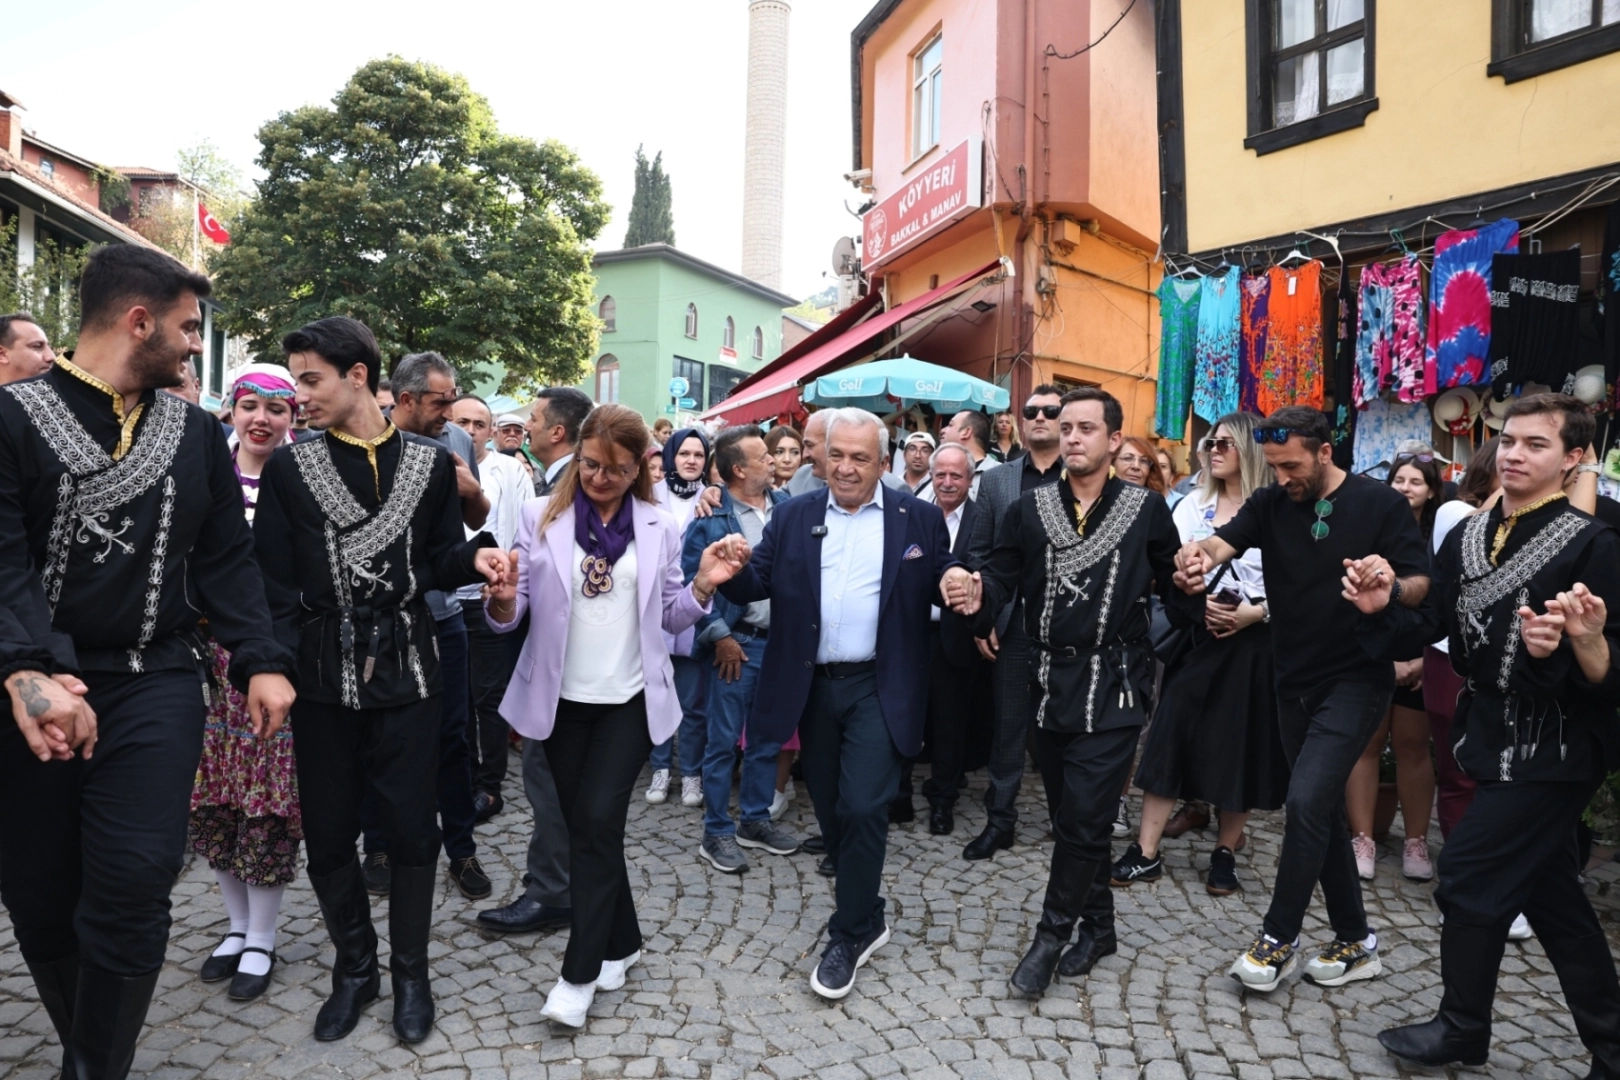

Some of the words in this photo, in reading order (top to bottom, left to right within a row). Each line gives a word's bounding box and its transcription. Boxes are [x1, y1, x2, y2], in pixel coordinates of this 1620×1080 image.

[898, 159, 956, 219] KÖYYERİ
[890, 219, 920, 247] BAKKAL
[922, 212, 929, 227] &
[930, 190, 962, 222] MANAV
[838, 378, 864, 391] Golf
[915, 380, 944, 393] Golf
